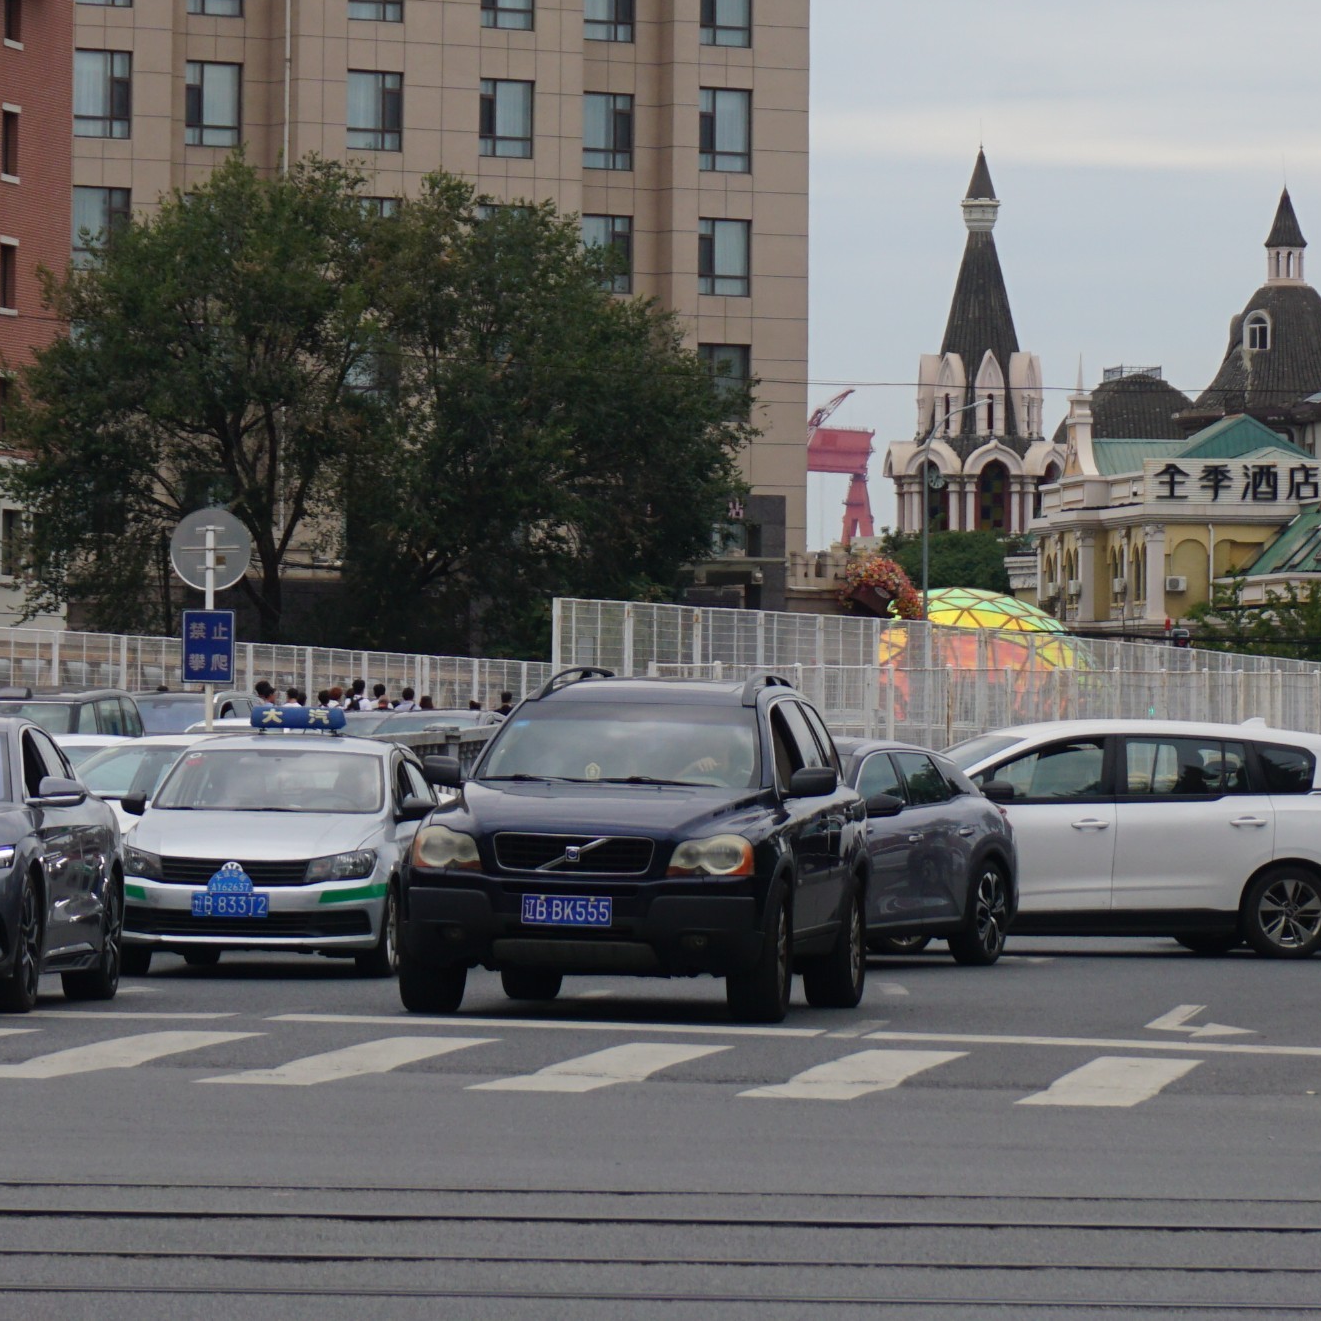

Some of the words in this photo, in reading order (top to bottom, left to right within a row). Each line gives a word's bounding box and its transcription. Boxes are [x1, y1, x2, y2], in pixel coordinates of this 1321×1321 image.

[1153, 463, 1320, 503] 全季酒店
[189, 621, 229, 640] 禁止
[261, 708, 331, 725] 大汽
